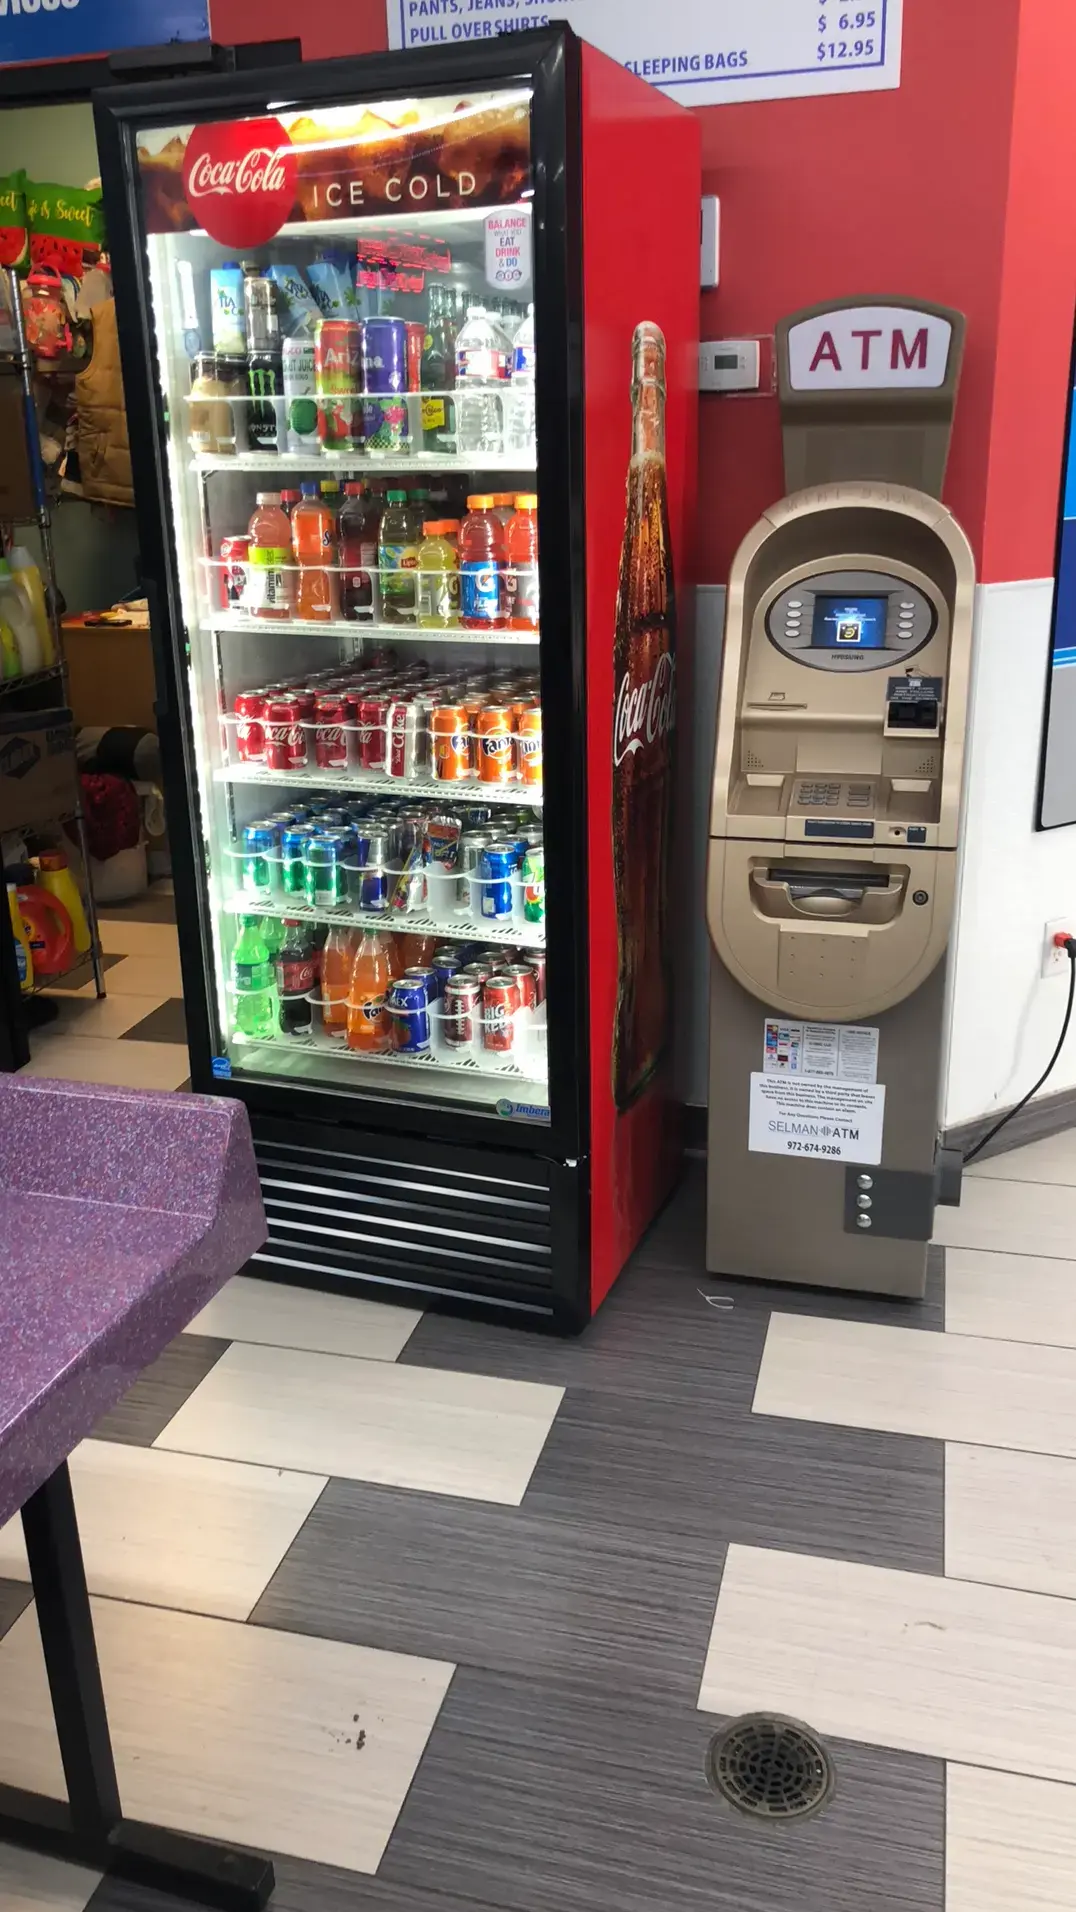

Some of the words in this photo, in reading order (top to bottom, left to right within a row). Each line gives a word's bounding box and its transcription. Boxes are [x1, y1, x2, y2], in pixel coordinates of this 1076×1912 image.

[409, 0, 463, 17] PANTS,
[817, 14, 827, 33] $
[838, 11, 876, 30] 6.95
[410, 25, 447, 43] PULL
[451, 22, 493, 39] OVER
[816, 39, 874, 61] $12.95
[624, 54, 701, 77] SLEEPING
[704, 51, 748, 71] BAGS
[188, 147, 286, 197] Coca-Cola
[313, 181, 364, 208] ICE
[385, 171, 476, 202] COLD
[488, 218, 527, 230] BALANCE
[499, 236, 515, 247] EAT
[495, 247, 521, 257] DRINK
[506, 257, 518, 267] DO
[808, 328, 929, 372] ATM
[516, 1103, 550, 1117] Imbera
[768, 1120, 820, 1136] SELMAN
[832, 1127, 860, 1140] ATM
[787, 1140, 841, 1156] 972-674-9286
